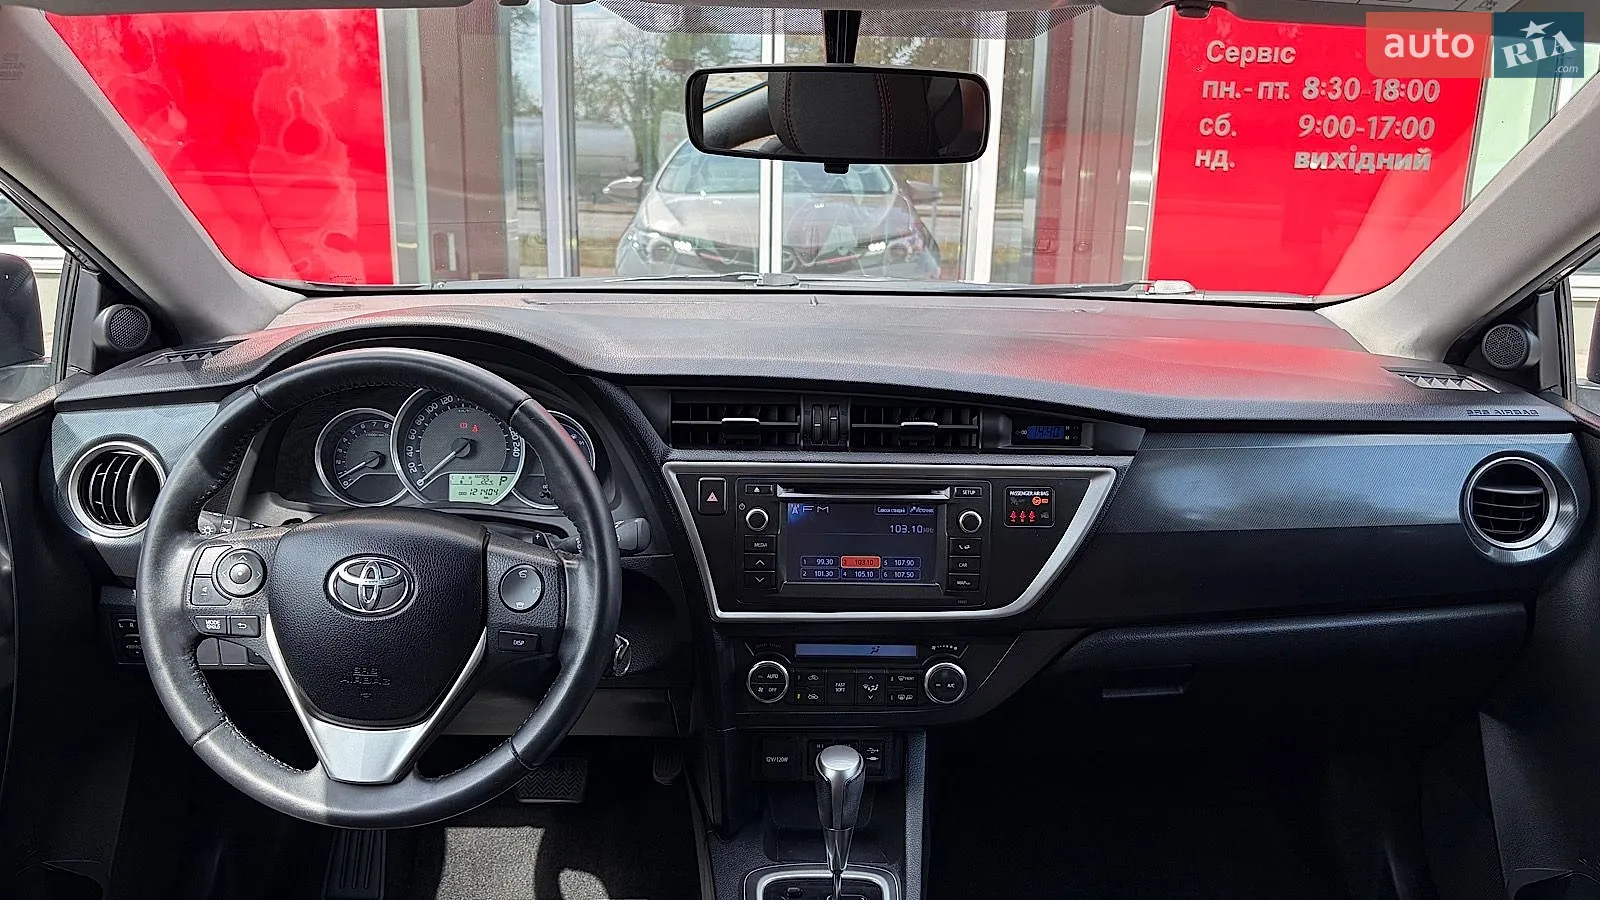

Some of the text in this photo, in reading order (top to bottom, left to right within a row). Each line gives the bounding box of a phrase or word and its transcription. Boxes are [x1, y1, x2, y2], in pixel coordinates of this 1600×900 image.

[1206, 40, 1296, 69] Сервіс
[1199, 113, 1435, 140] сб. 9:00-17:00
[1194, 145, 1432, 174] нд. вихідний
[440, 395, 453, 405] 120
[425, 402, 438, 414] 100
[415, 414, 425, 426] 80
[408, 429, 417, 440] 60
[406, 445, 414, 457] 40
[512, 441, 520, 458] 240
[407, 462, 418, 474] 20
[416, 479, 424, 487] 0
[498, 475, 508, 486] P
[469, 487, 499, 496] 121404
[889, 524, 923, 534] 103.10
[894, 559, 915, 567] 107.90
